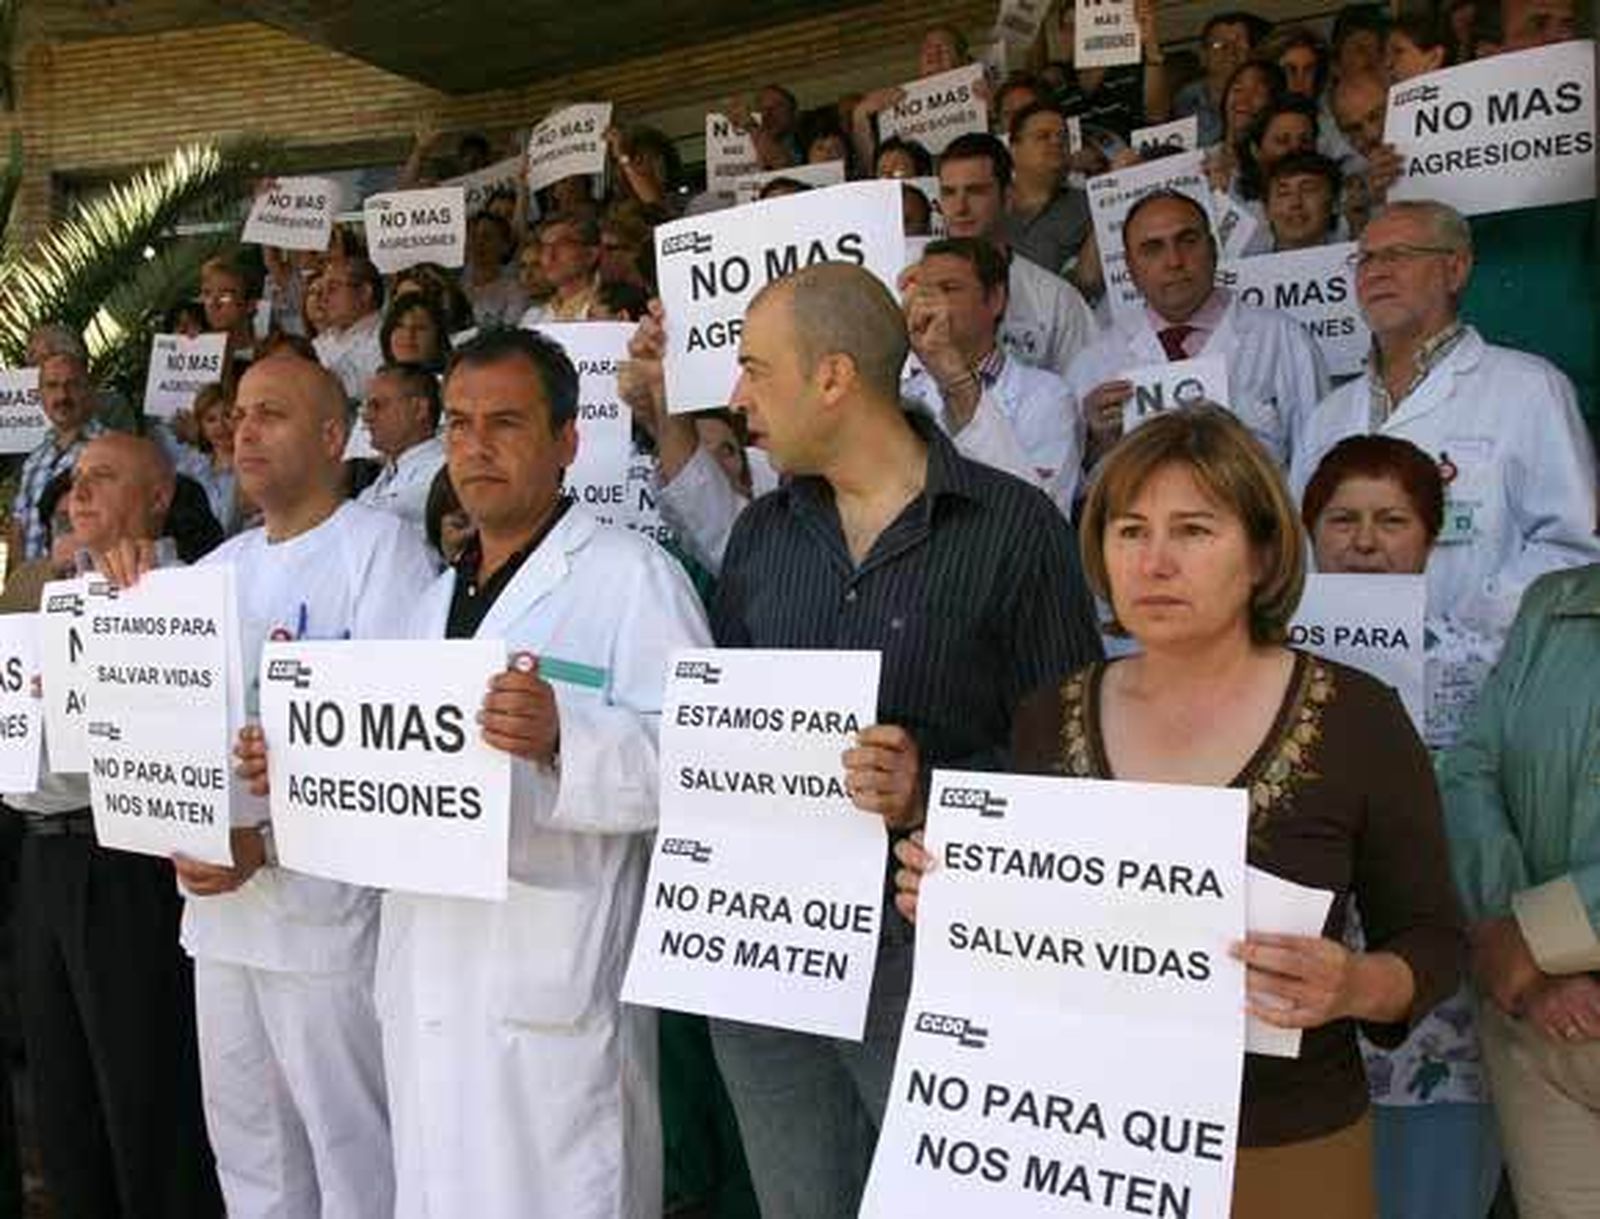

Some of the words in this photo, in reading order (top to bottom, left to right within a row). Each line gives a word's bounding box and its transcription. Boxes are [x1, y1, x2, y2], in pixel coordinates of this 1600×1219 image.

[927, 85, 970, 109] MAS
[1414, 101, 1473, 137] NO
[1488, 81, 1583, 125] MAS
[561, 117, 596, 138] MAS
[1408, 131, 1594, 178] AGRESIONES
[268, 193, 291, 210] NO
[295, 194, 327, 211] MAS
[379, 210, 407, 228] NO
[411, 207, 452, 226] MAS
[691, 256, 751, 300] NO
[1274, 276, 1348, 310] MAS
[167, 353, 185, 372] NO
[187, 353, 220, 373] MAS
[584, 484, 624, 506] QUE
[93, 616, 167, 636] ESTAMOS
[170, 619, 217, 637] PARA
[1334, 626, 1410, 650] PARA
[98, 664, 160, 686] SALVAR
[162, 667, 213, 688] VIDAS
[288, 700, 345, 747] NO
[360, 703, 466, 754] MAS
[676, 704, 785, 733] ESTAMOS
[790, 710, 860, 736] PARA
[92, 756, 120, 779] NO
[124, 760, 177, 786] PARA
[181, 765, 225, 791] QUE
[680, 767, 777, 796] SALVAR
[782, 775, 854, 800] VIDA
[105, 793, 143, 817] NOS
[147, 798, 215, 825] MATEN
[288, 774, 483, 820] AGRESIONES
[944, 842, 1106, 887] ESTAMOS
[1116, 860, 1225, 900] PARA
[655, 881, 699, 913] NO
[706, 889, 793, 925] PARA
[802, 898, 876, 934] QUE
[660, 929, 727, 964] NOS
[733, 939, 849, 982] MATEN
[948, 922, 1086, 968] SALVAR
[1096, 942, 1212, 982] VIDAS
[906, 1069, 970, 1112] NO
[982, 1083, 1107, 1140] PARA
[1121, 1109, 1227, 1162] QUE
[914, 1132, 1011, 1183] NOS
[1023, 1154, 1192, 1219] MATEN
